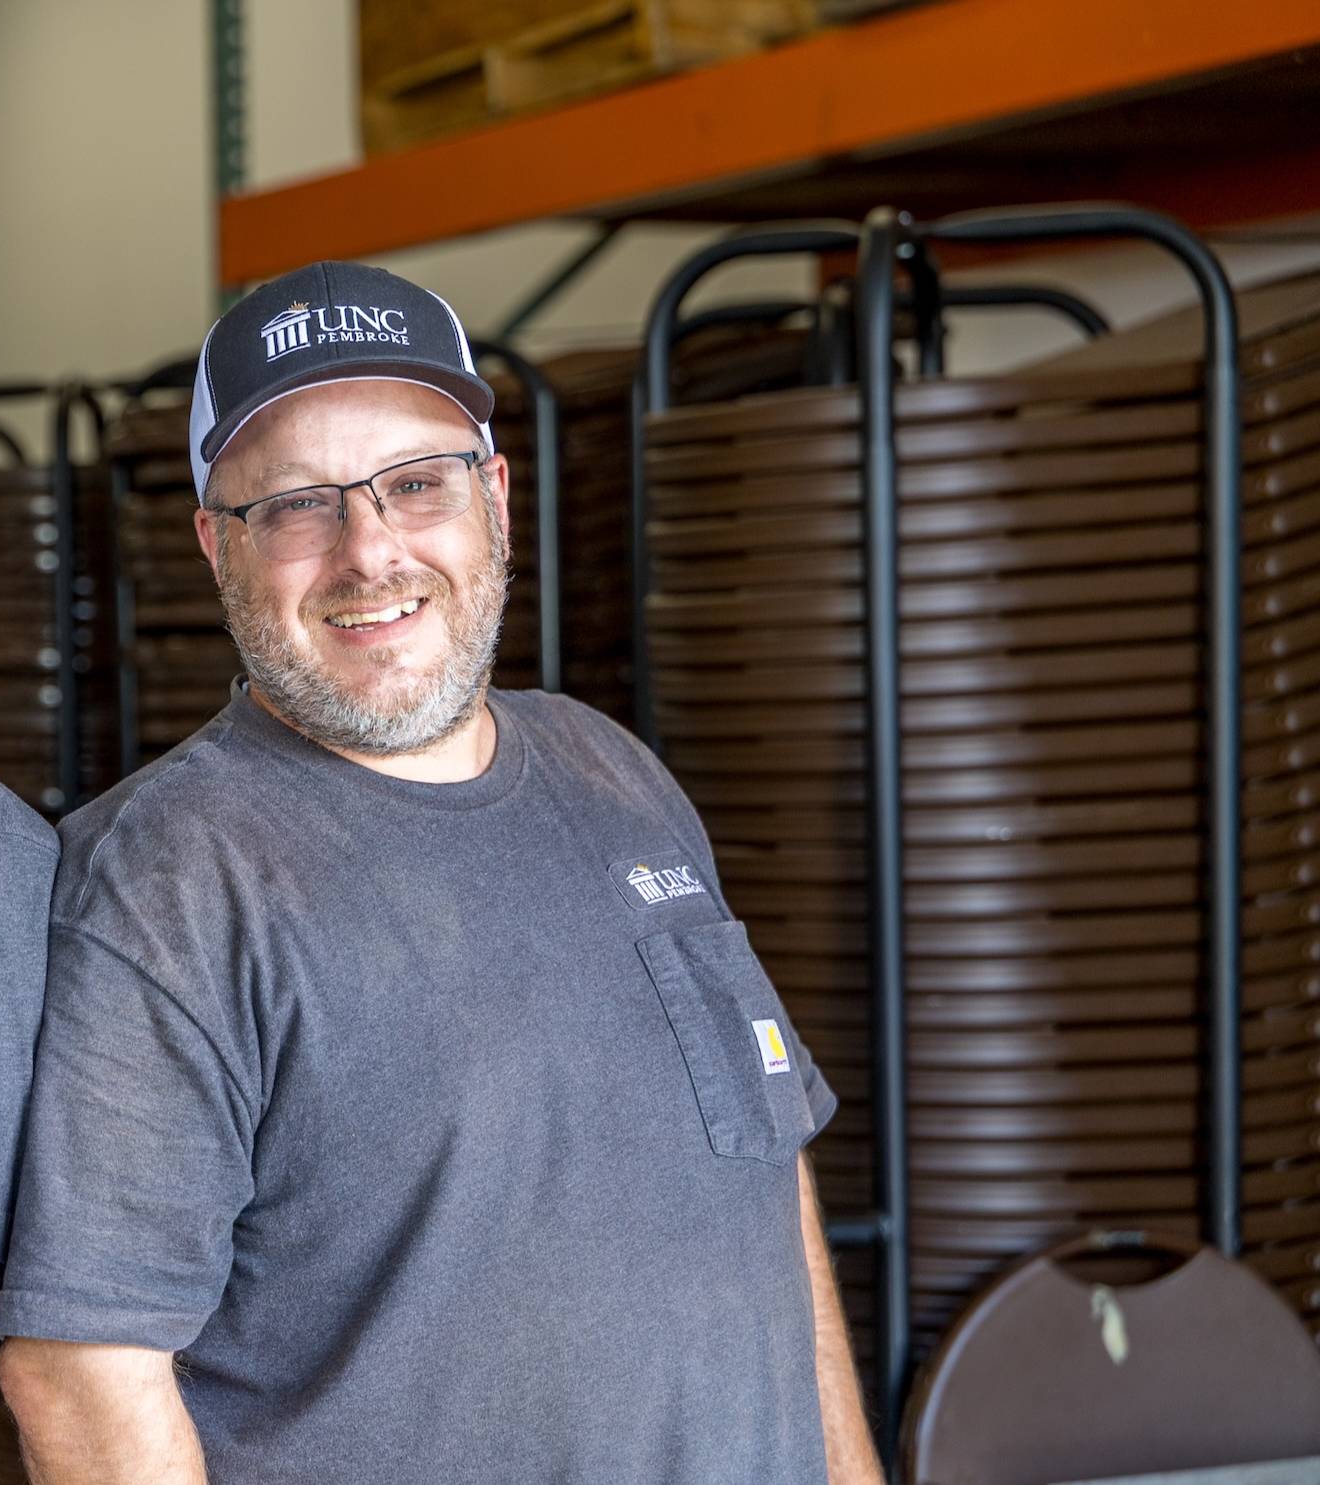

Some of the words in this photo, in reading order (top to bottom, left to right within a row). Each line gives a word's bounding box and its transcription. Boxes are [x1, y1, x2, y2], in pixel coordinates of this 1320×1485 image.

[311, 305, 408, 335] UNC
[317, 331, 410, 346] PEMBROKE
[653, 865, 700, 890] UNC
